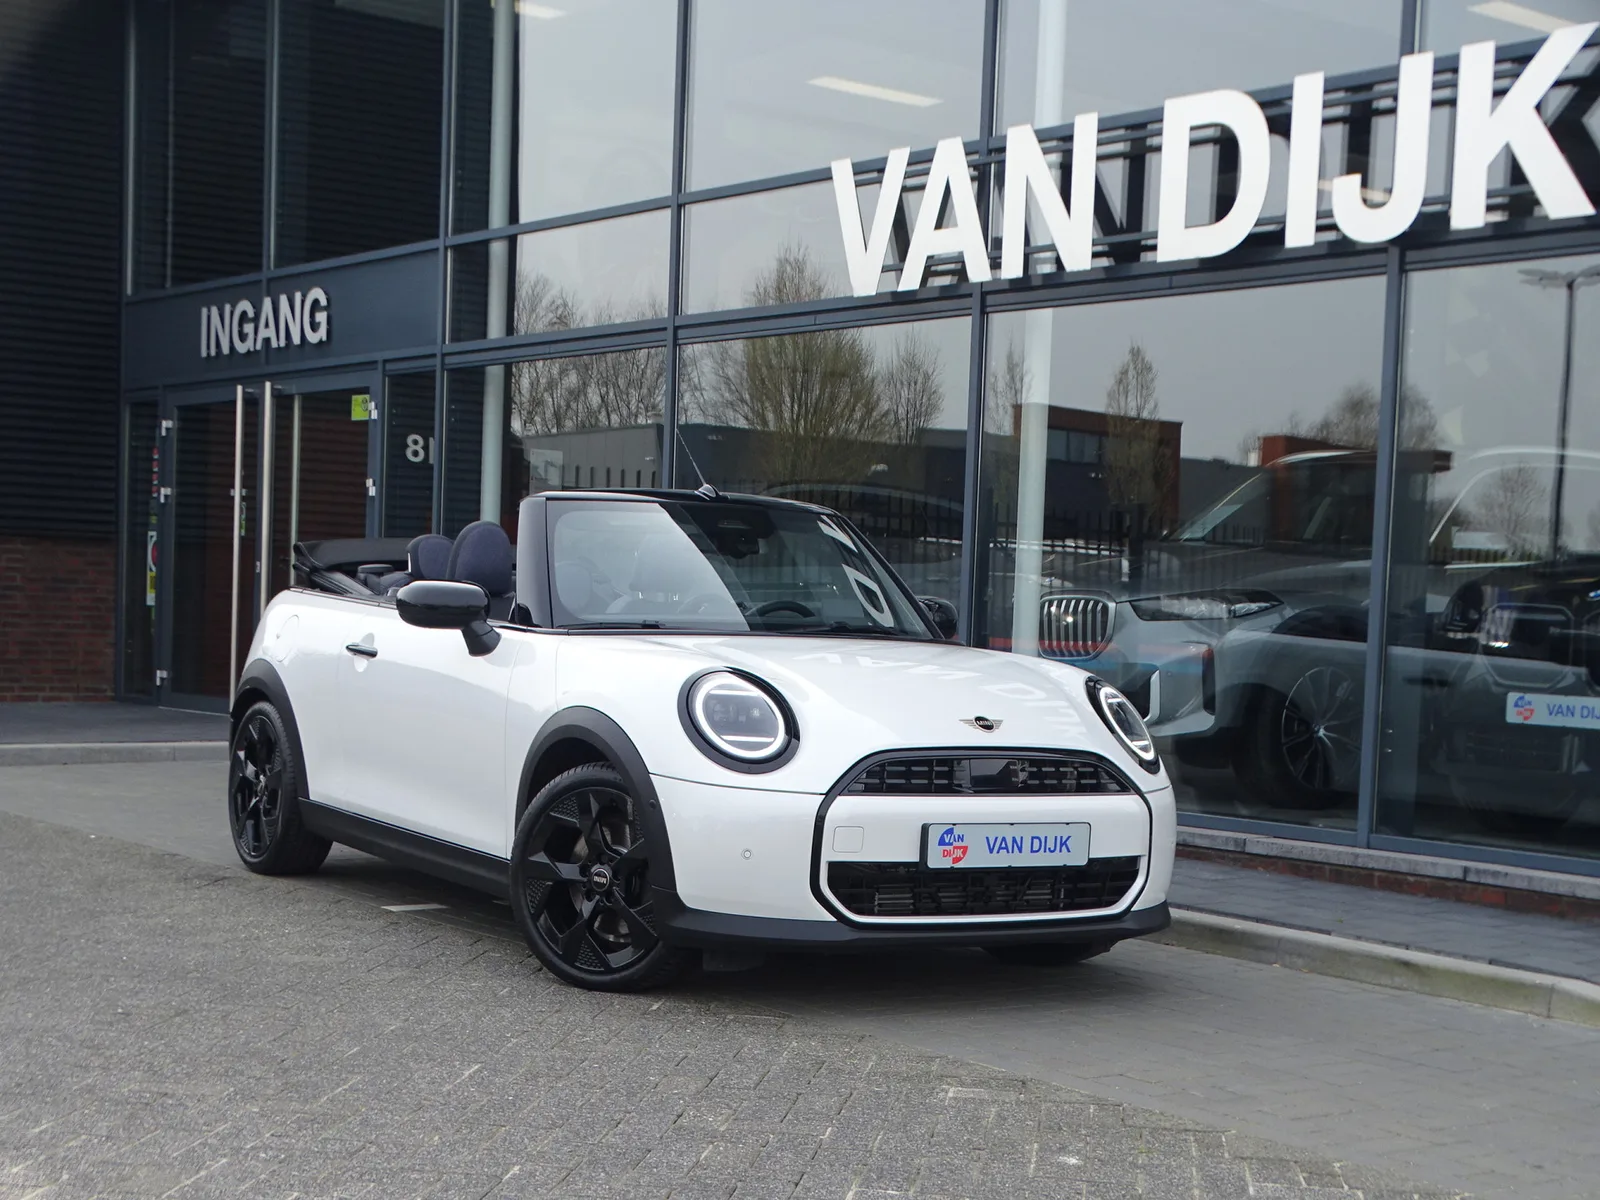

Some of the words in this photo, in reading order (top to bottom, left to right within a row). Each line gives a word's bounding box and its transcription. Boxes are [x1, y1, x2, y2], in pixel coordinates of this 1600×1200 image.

[831, 112, 1098, 297] VAN
[1157, 22, 1600, 263] DIJK
[200, 286, 328, 358] INGANG
[943, 833, 965, 843] VAN
[985, 836, 1024, 854] VAN
[1030, 835, 1072, 854] DIJK
[942, 848, 964, 858] DIJK
